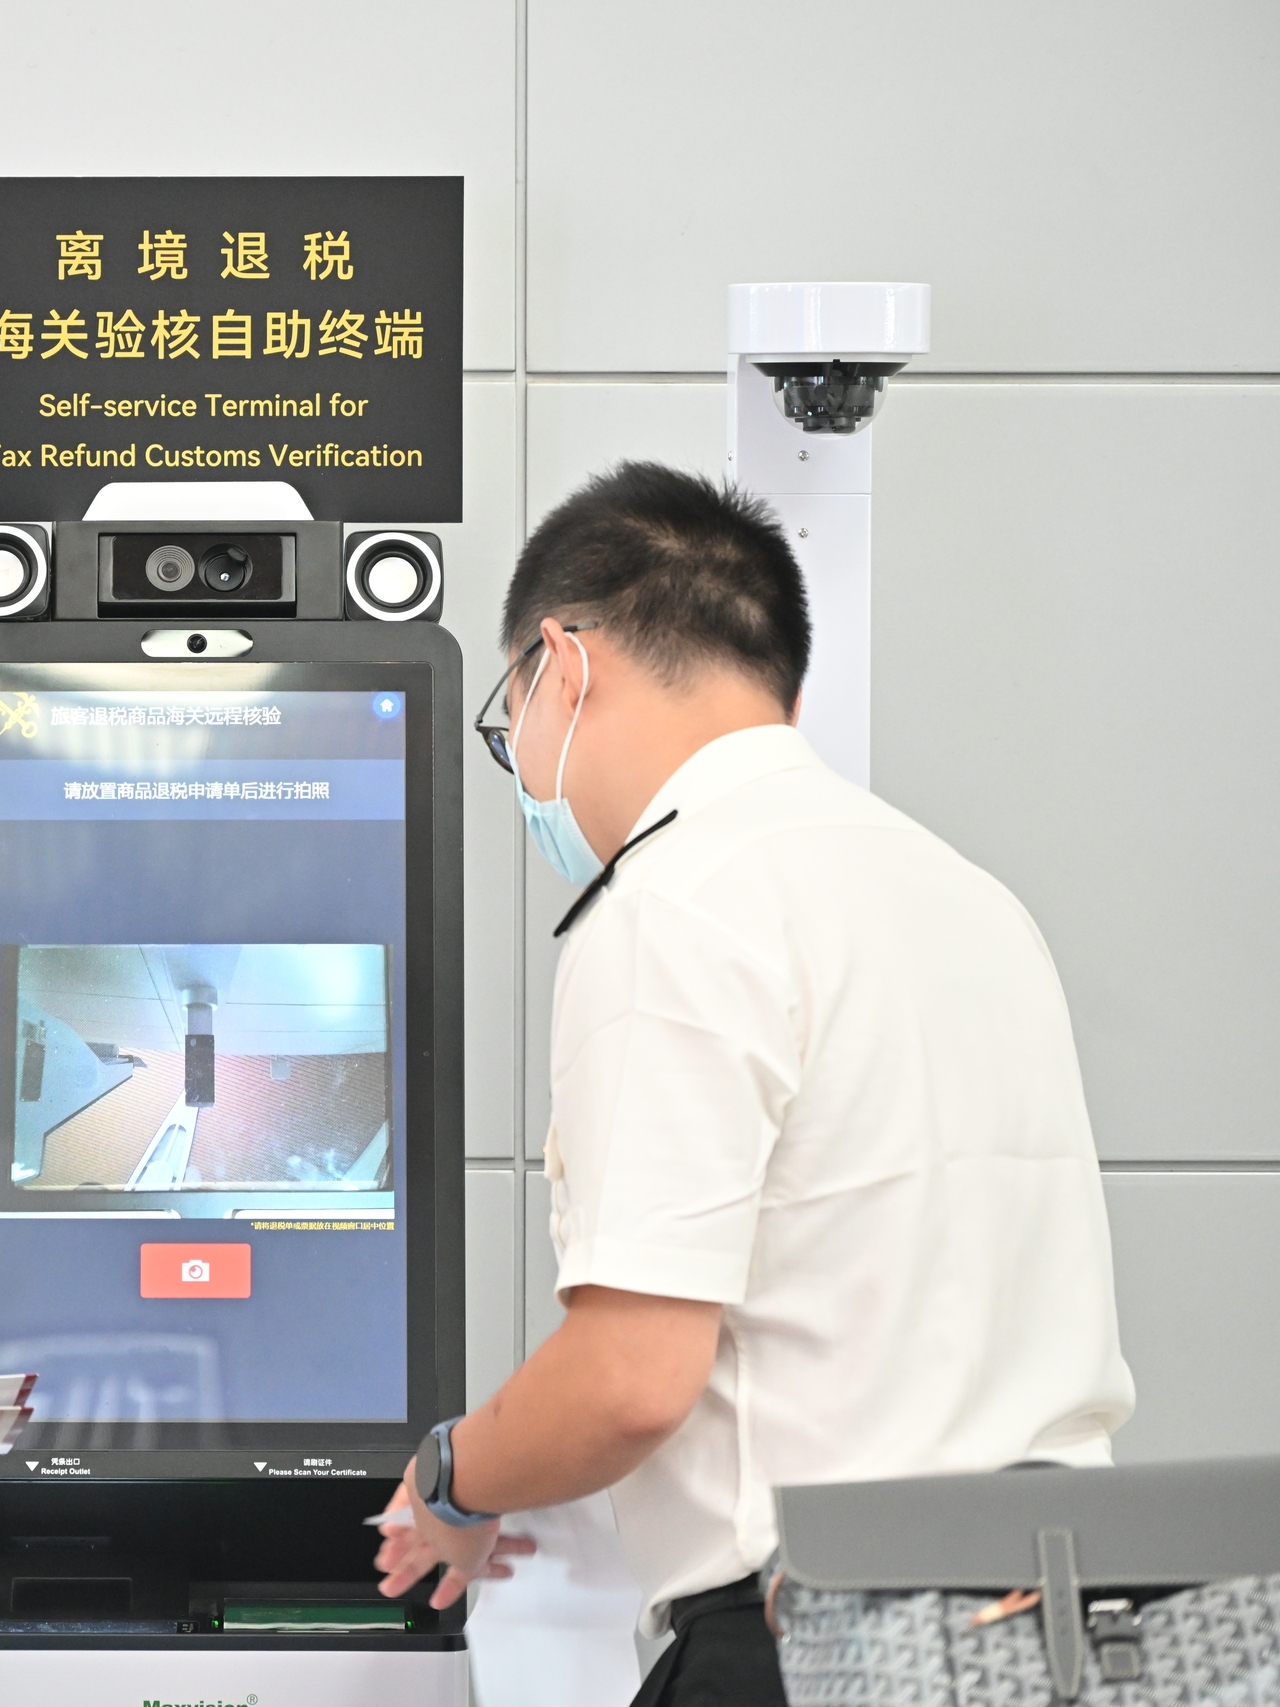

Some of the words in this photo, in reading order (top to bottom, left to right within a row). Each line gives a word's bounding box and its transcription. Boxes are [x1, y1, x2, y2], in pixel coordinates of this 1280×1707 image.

[56, 230, 354, 280] 离境退税
[39, 393, 197, 417] Self-service
[205, 393, 320, 417] Terminal
[329, 393, 369, 417] for
[41, 443, 136, 467] Refund
[145, 443, 260, 467] Customs
[269, 443, 423, 467] Verification
[50, 706, 282, 726] 旅客退税商品海关远程核验
[63, 781, 330, 800] 请放置商品退税申请单后进行拍照
[40, 1467, 68, 1476] Receipt
[69, 1467, 91, 1475] Outlet
[268, 1468, 292, 1476] Please
[293, 1468, 312, 1476] Scan
[312, 1468, 330, 1476] Your
[330, 1468, 368, 1476] Certificate
